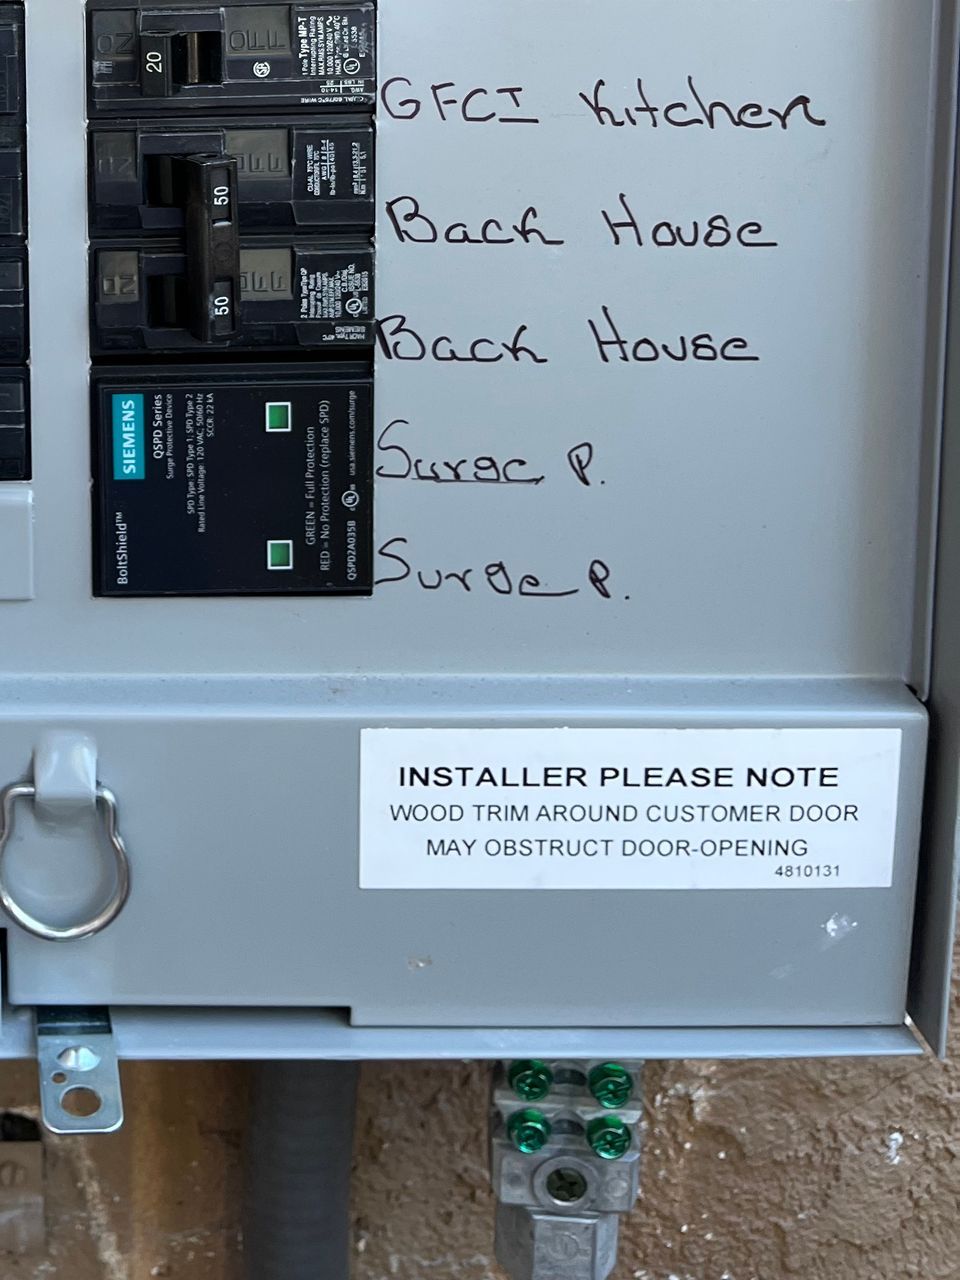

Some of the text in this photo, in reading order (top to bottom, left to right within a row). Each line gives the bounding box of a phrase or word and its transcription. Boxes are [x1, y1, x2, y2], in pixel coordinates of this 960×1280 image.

[146, 52, 162, 73] 20
[379, 76, 826, 129] GFCI Kitchen
[214, 186, 229, 205] 50
[386, 193, 778, 249] Back House
[214, 296, 229, 315] 50
[375, 305, 760, 364] Back House
[196, 394, 203, 403] Hz
[206, 393, 214, 402] kA
[186, 400, 194, 417] Type
[206, 405, 214, 414] 22
[319, 400, 330, 424] SPD)
[152, 394, 164, 459] QSPD Series
[347, 391, 357, 476] usa.siemens.com/surge
[122, 400, 136, 474] SIEMENS
[319, 427, 331, 467] (replace
[186, 444, 195, 461] Type
[305, 427, 315, 478] Protection
[165, 458, 175, 479] Surge
[305, 481, 315, 499] Full
[320, 471, 329, 521] Protection
[187, 500, 195, 514] SPD
[306, 511, 316, 545] GREEN
[320, 524, 329, 539] No
[320, 551, 330, 571] RED
[399, 766, 839, 787] INSTALLER PLEASE NOTE
[389, 803, 859, 822] WOOD TRIM AROUND CUSTOMER DOOR
[426, 839, 808, 857] MAY OBSTRUCT DOOR-OPENING
[775, 865, 840, 877] 4810131
